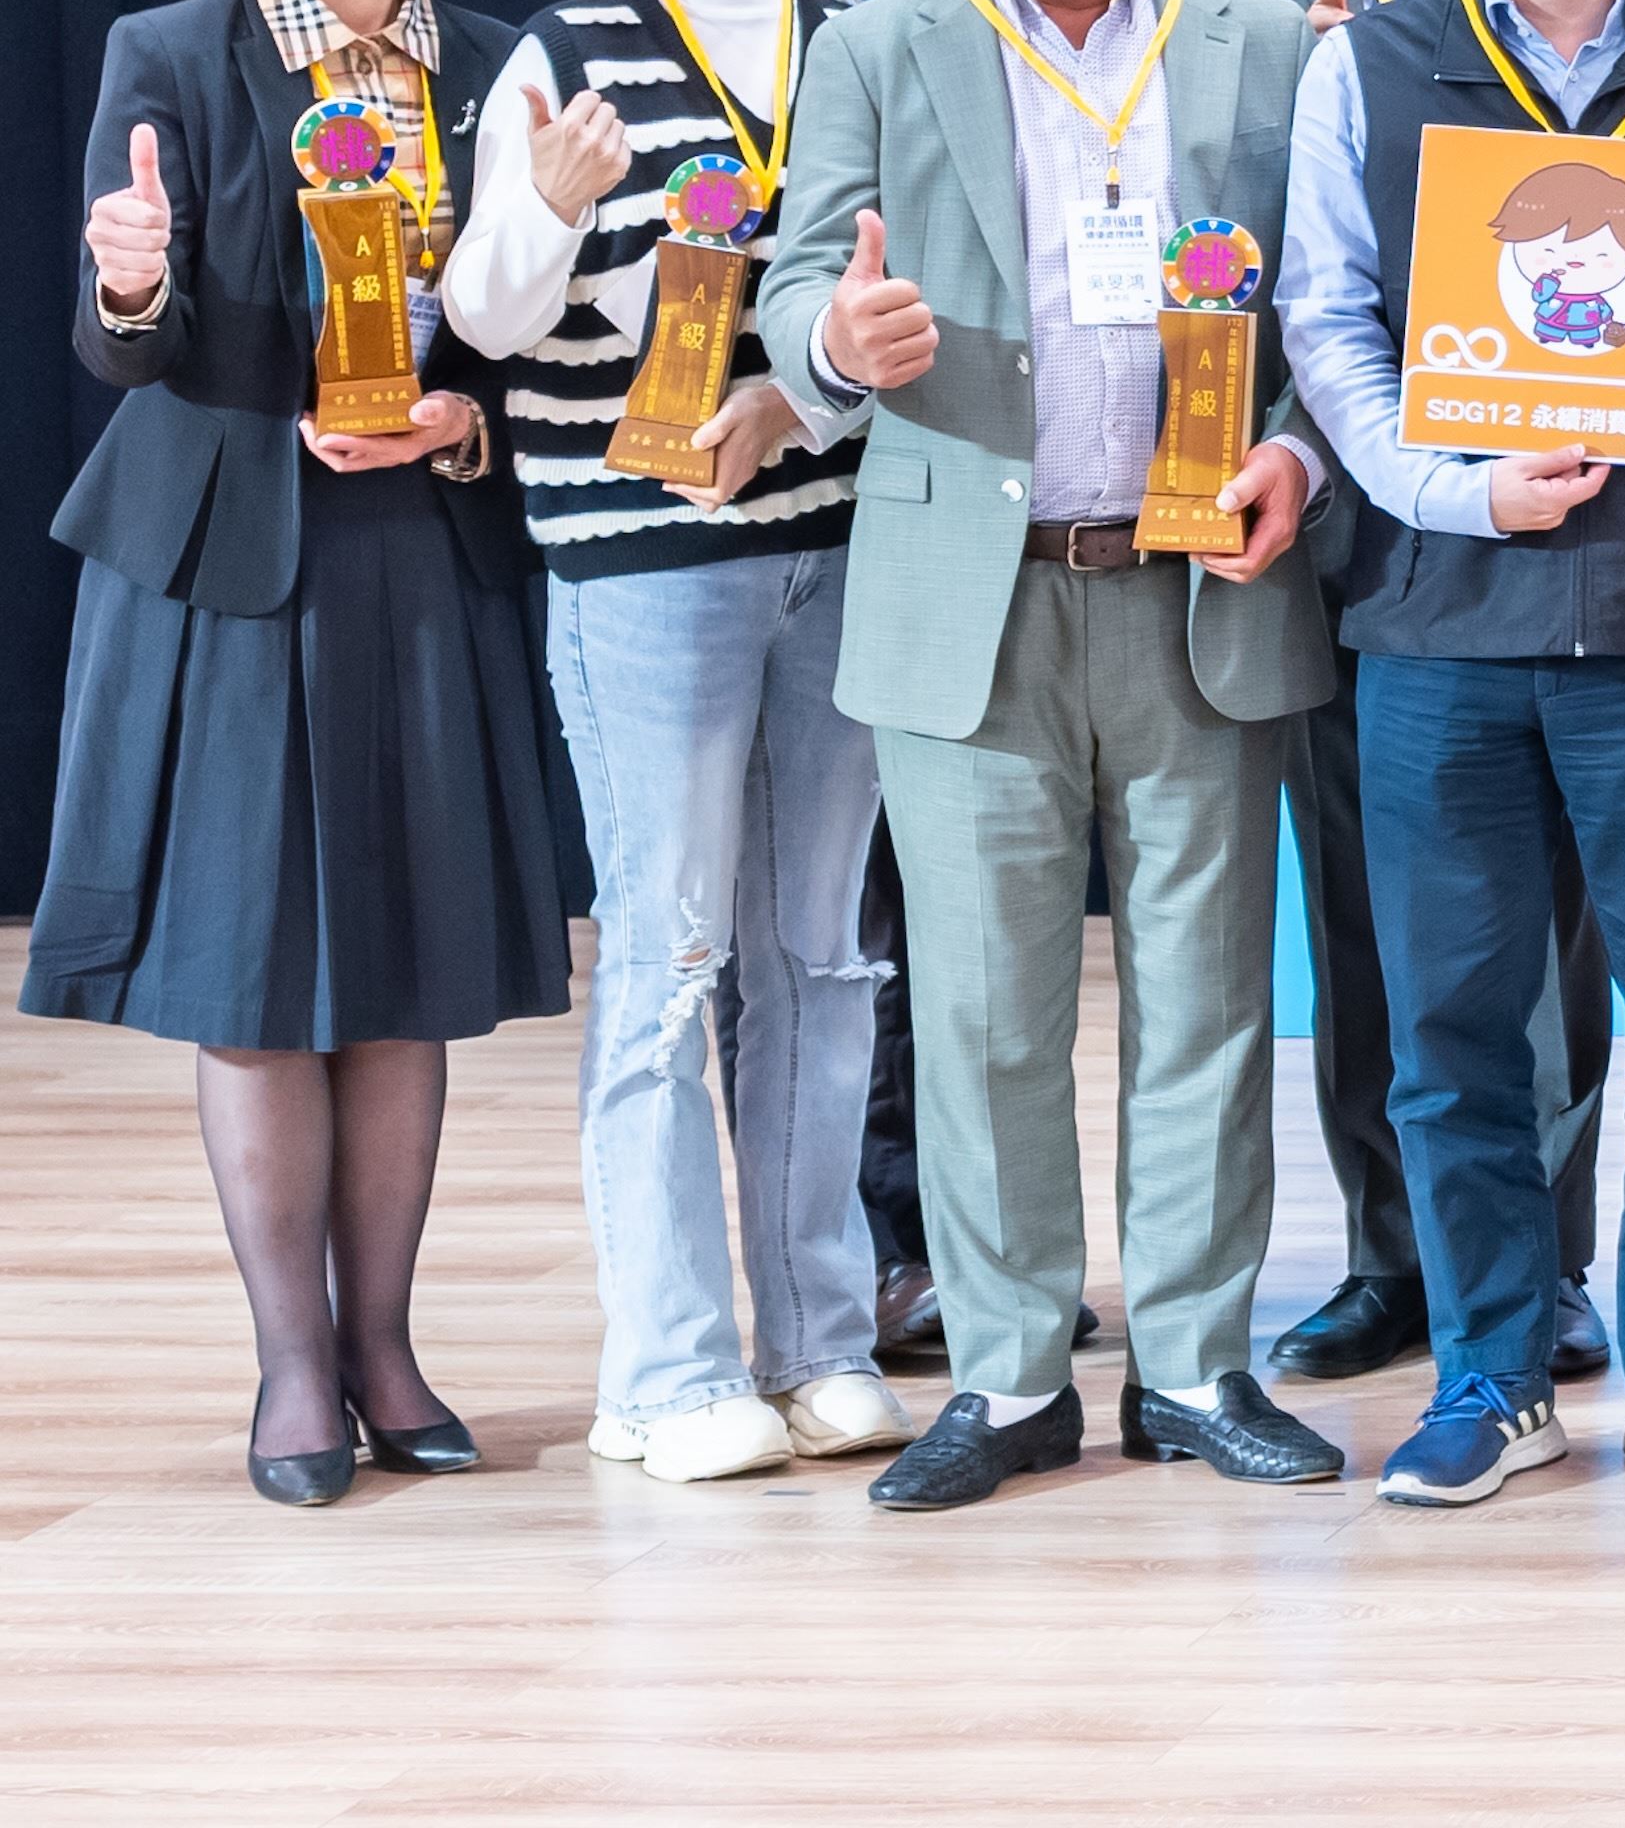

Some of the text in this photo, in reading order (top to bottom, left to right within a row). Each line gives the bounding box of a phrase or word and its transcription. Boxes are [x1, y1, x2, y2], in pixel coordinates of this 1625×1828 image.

[352, 275, 382, 303] 級
[676, 322, 707, 352] 級
[1189, 388, 1217, 418] 級
[1425, 399, 1522, 427] SDG12
